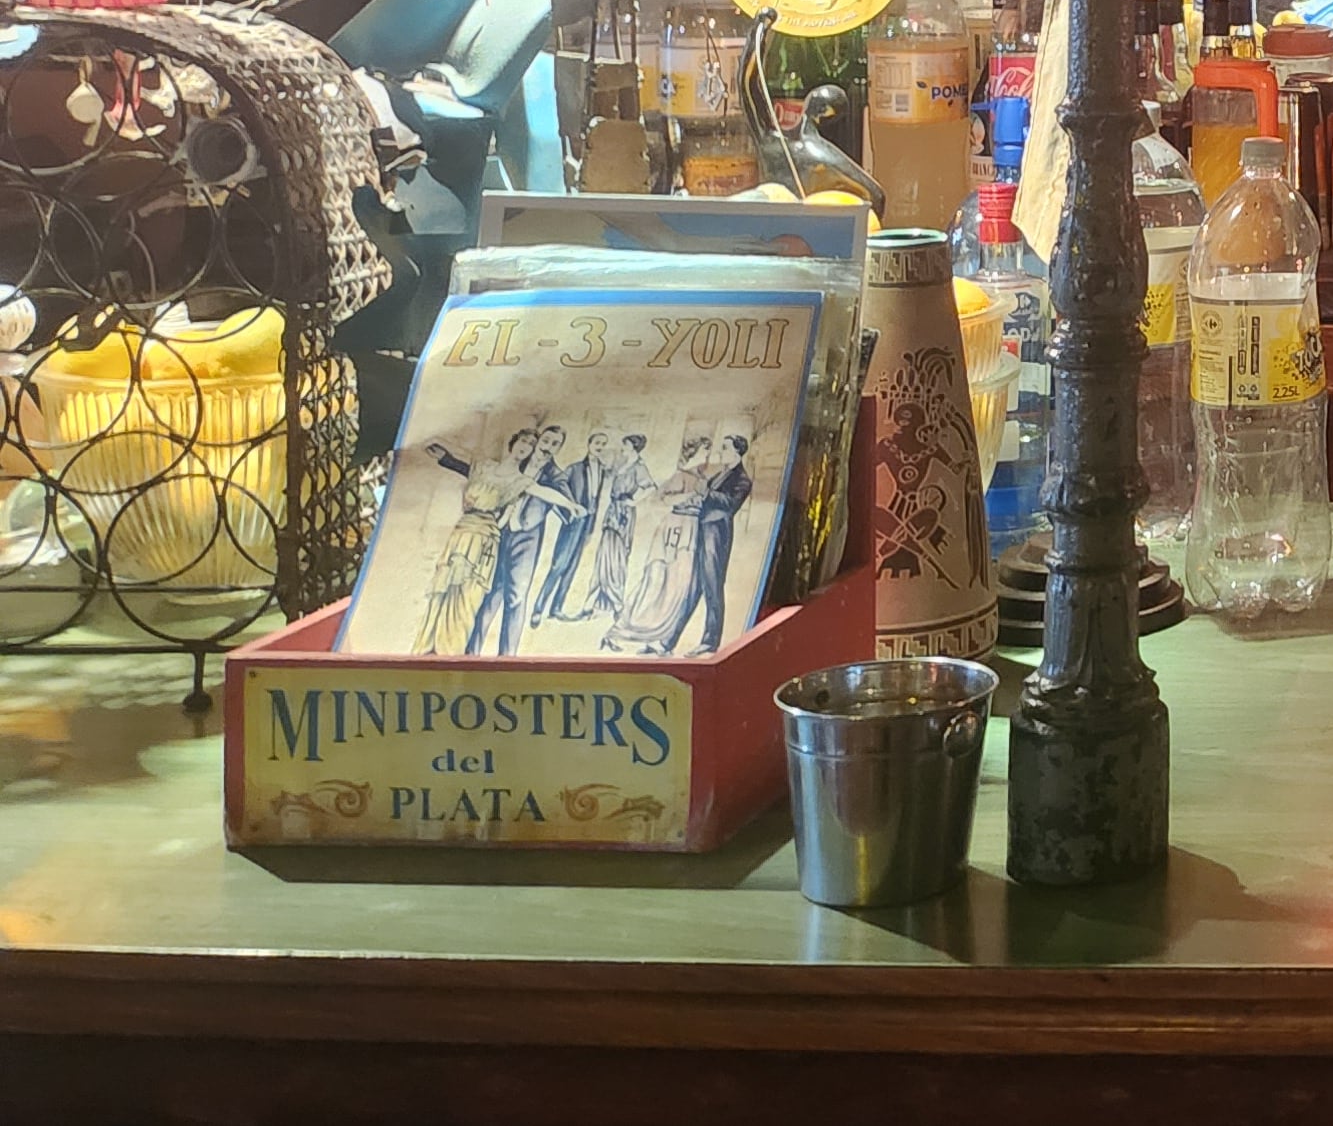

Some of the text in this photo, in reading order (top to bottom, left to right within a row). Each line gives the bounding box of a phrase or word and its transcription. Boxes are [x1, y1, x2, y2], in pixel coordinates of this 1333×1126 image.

[932, 83, 968, 100] POME
[443, 319, 521, 367] EL
[646, 317, 790, 370] YOLI
[266, 687, 671, 766] MINIPOSTERS
[431, 747, 496, 775] del
[388, 784, 547, 823] PLATA
